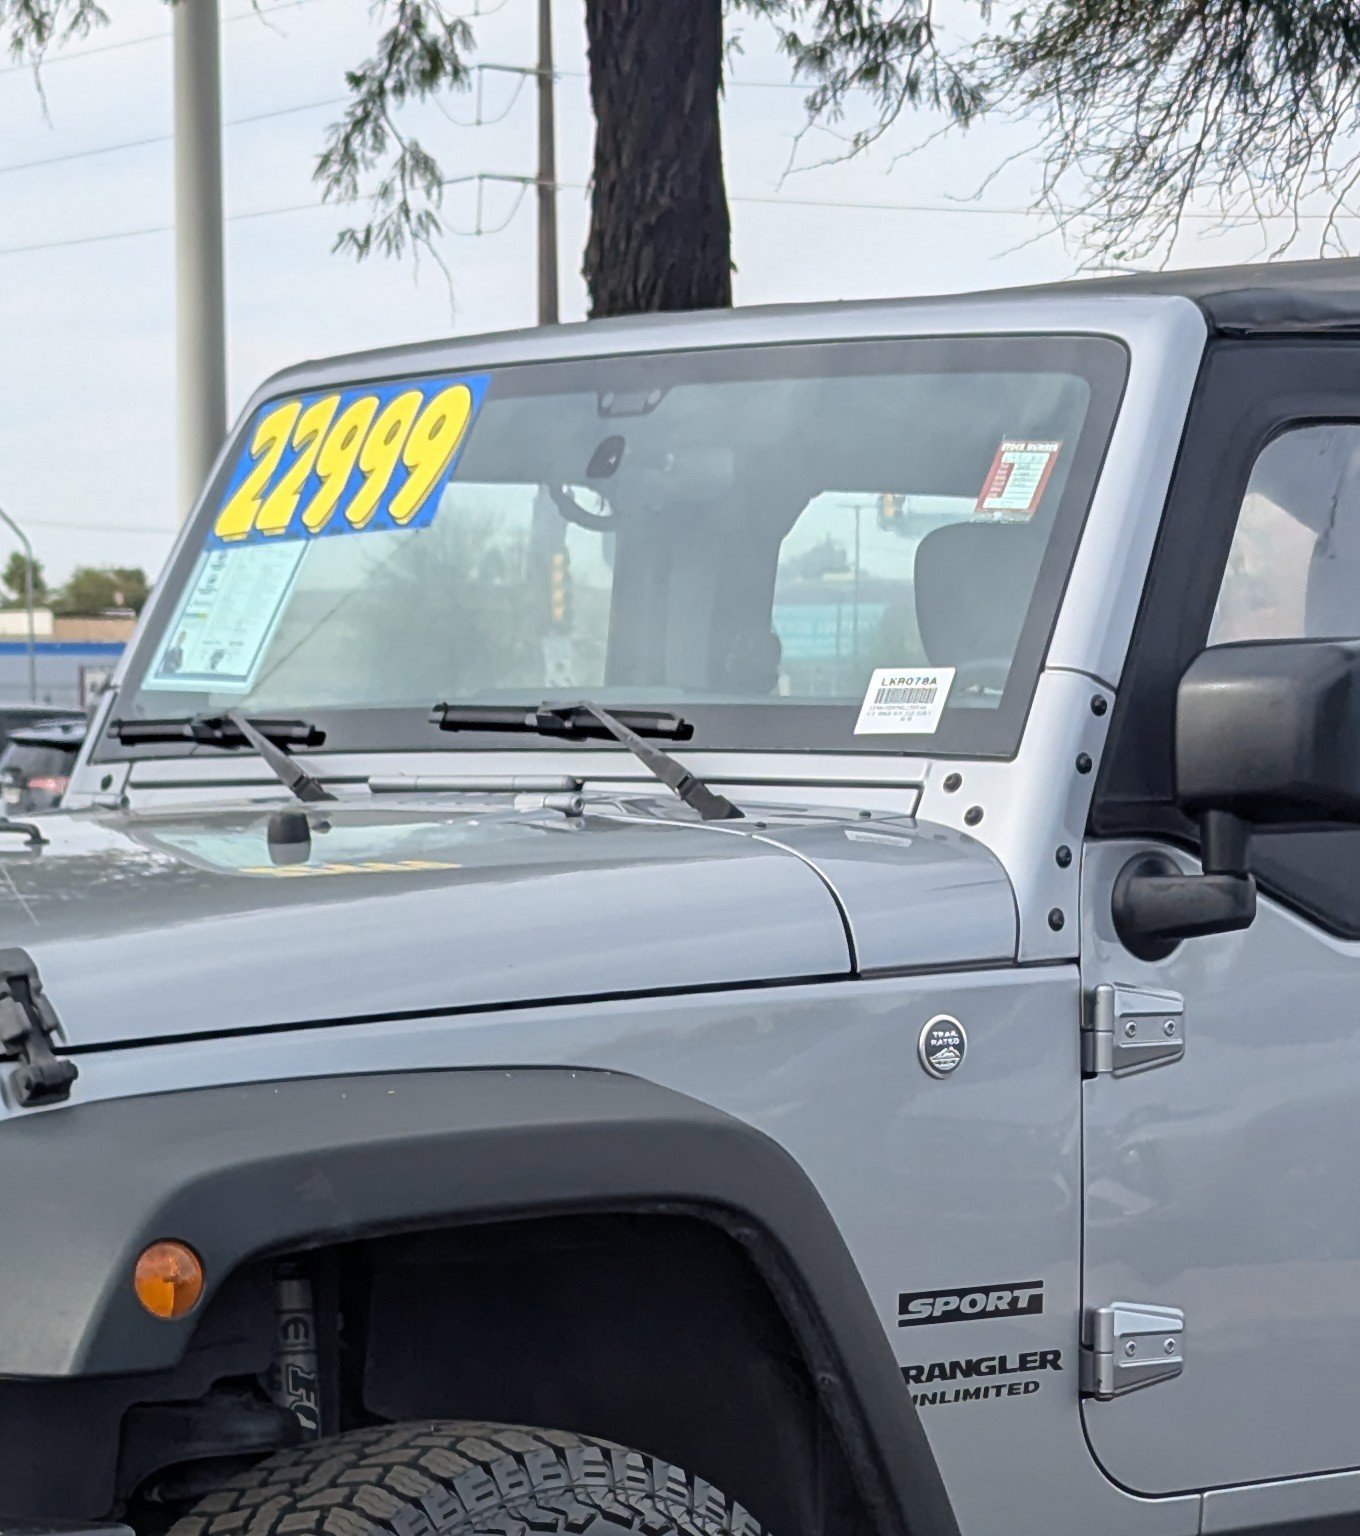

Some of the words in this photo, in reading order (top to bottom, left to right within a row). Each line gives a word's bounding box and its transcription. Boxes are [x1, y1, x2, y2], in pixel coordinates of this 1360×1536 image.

[214, 384, 472, 542] 22999
[930, 1037, 960, 1046] RATED
[898, 1287, 1043, 1322] SPORT
[900, 1349, 1064, 1385] RANGLER
